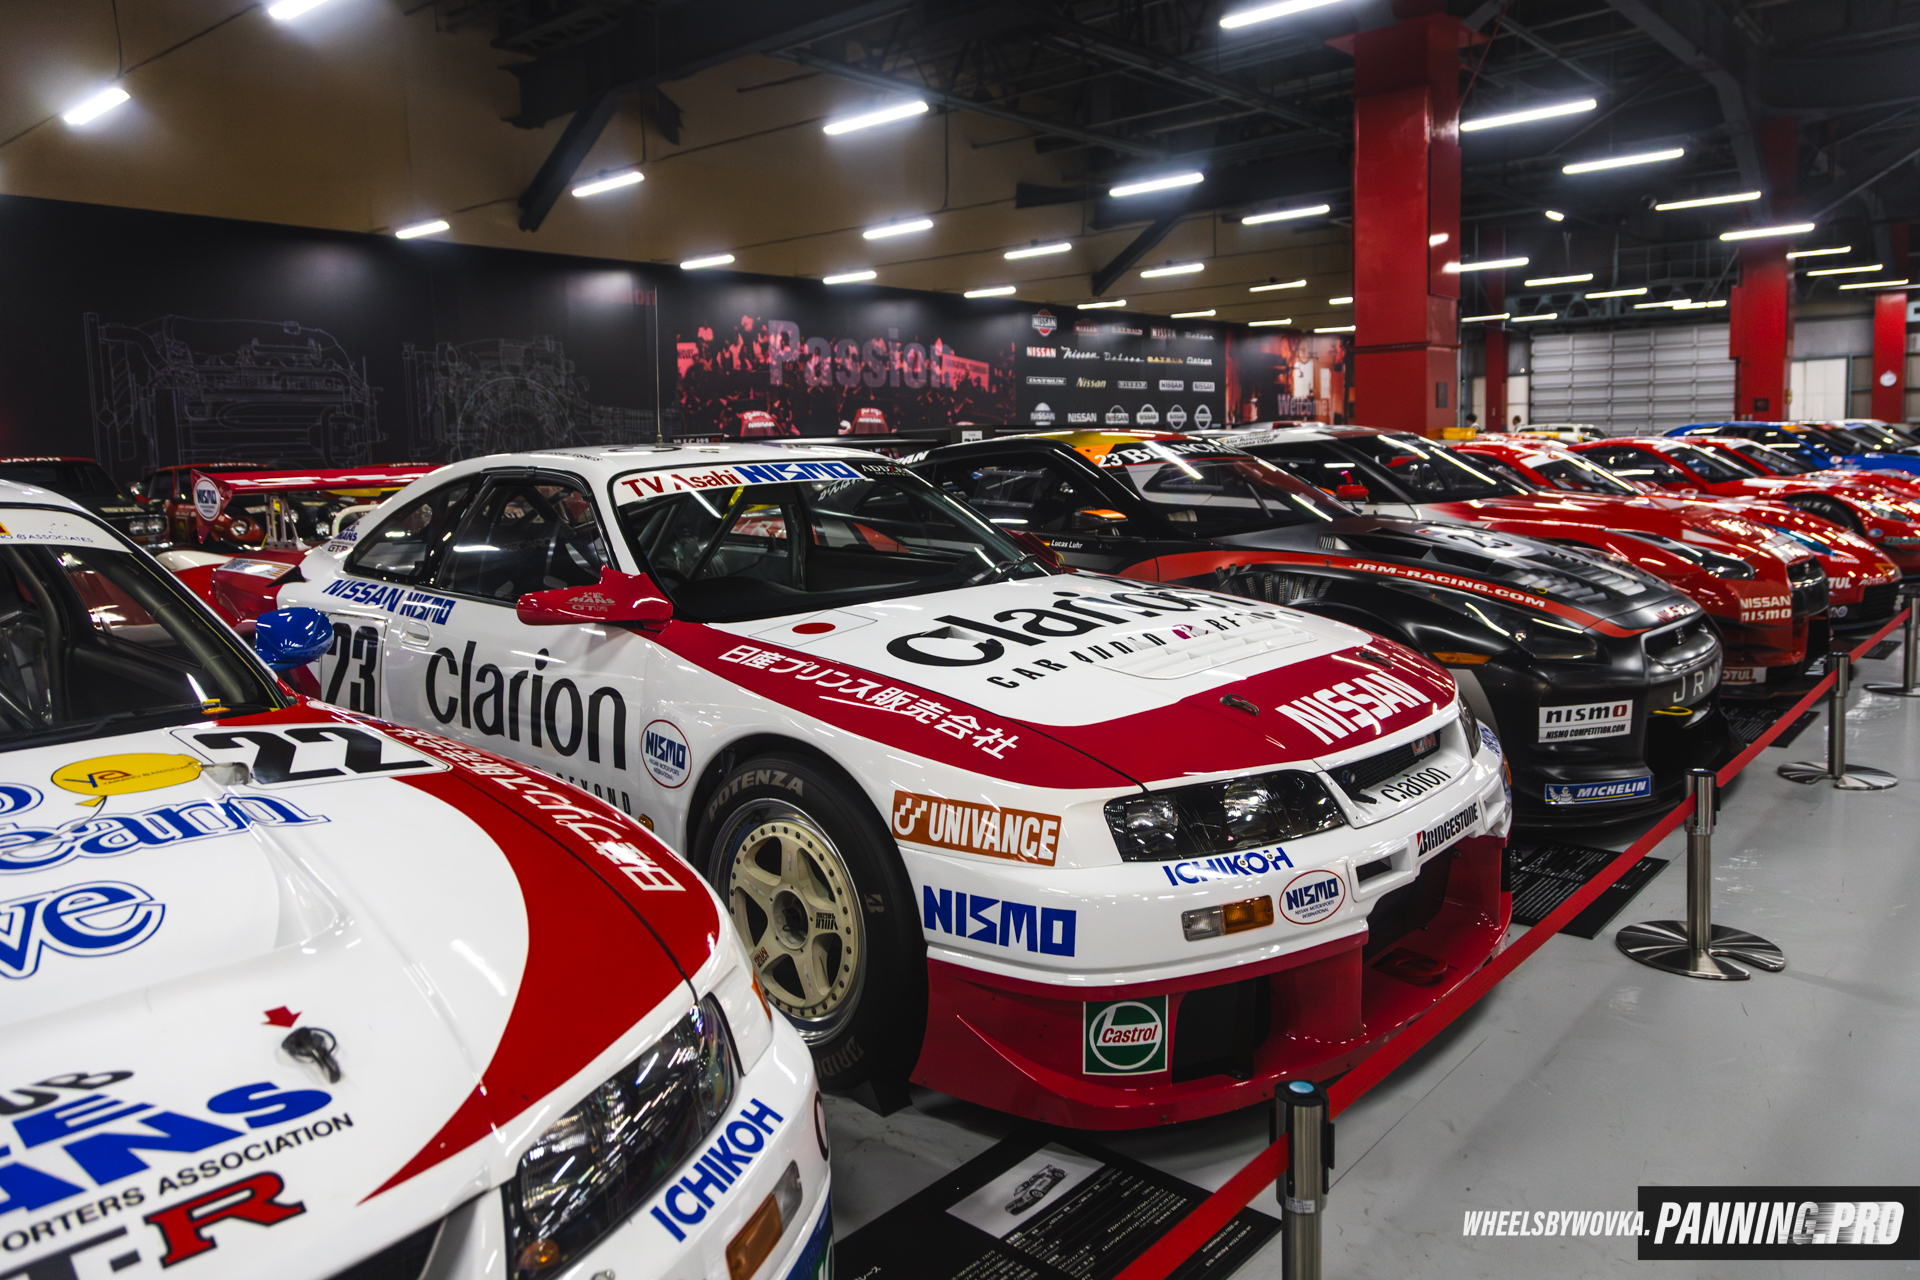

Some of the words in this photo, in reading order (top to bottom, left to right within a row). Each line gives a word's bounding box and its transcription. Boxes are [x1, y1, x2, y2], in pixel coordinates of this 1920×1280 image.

[1033, 316, 1057, 327] NISSAN
[769, 320, 952, 388] Passion
[1027, 346, 1056, 358] NISSAN
[1076, 377, 1106, 388] Nissan
[1030, 412, 1056, 421] NISSAN
[1068, 413, 1097, 423] NISSAN
[1106, 413, 1129, 423] NISSAN
[732, 462, 862, 484] NISMO
[1094, 454, 1123, 468] 23
[621, 475, 664, 497] TV
[670, 469, 742, 491] Asahi
[29, 534, 94, 543] ASSOCIATES
[1051, 539, 1068, 548] Lucas
[322, 579, 401, 613] NISSAN
[568, 596, 616, 604] MANS
[1349, 563, 1546, 608] JRM-RACING.COM
[400, 592, 457, 626] NISMO
[1741, 595, 1791, 609] NISSAN
[1741, 609, 1792, 622] nismo
[326, 621, 380, 718] 23
[987, 658, 1068, 689] CAR
[718, 644, 1019, 760] 日産プリンス販売会社
[1275, 671, 1431, 745] NISSAN
[1546, 703, 1628, 724] nismo
[1546, 729, 1569, 740] NISMO
[1569, 724, 1626, 738] COMPETITION.COM
[192, 727, 433, 784] 22
[645, 730, 687, 771] NISMO
[708, 769, 804, 823] POTENZA
[1576, 780, 1647, 798] MICHELIN
[928, 802, 1059, 860] UNIVANCE
[1418, 802, 1479, 858] BRIDGESTONE
[1161, 846, 1294, 886] ICHIKOH
[1286, 878, 1339, 911] NISMO
[923, 884, 1077, 957] NISMO
[1101, 1024, 1158, 1043] Castrol
[2, 1187, 146, 1252] ORTERS
[158, 1112, 354, 1196] ASSOCIATION
[650, 1098, 784, 1243] ICHIKOH
